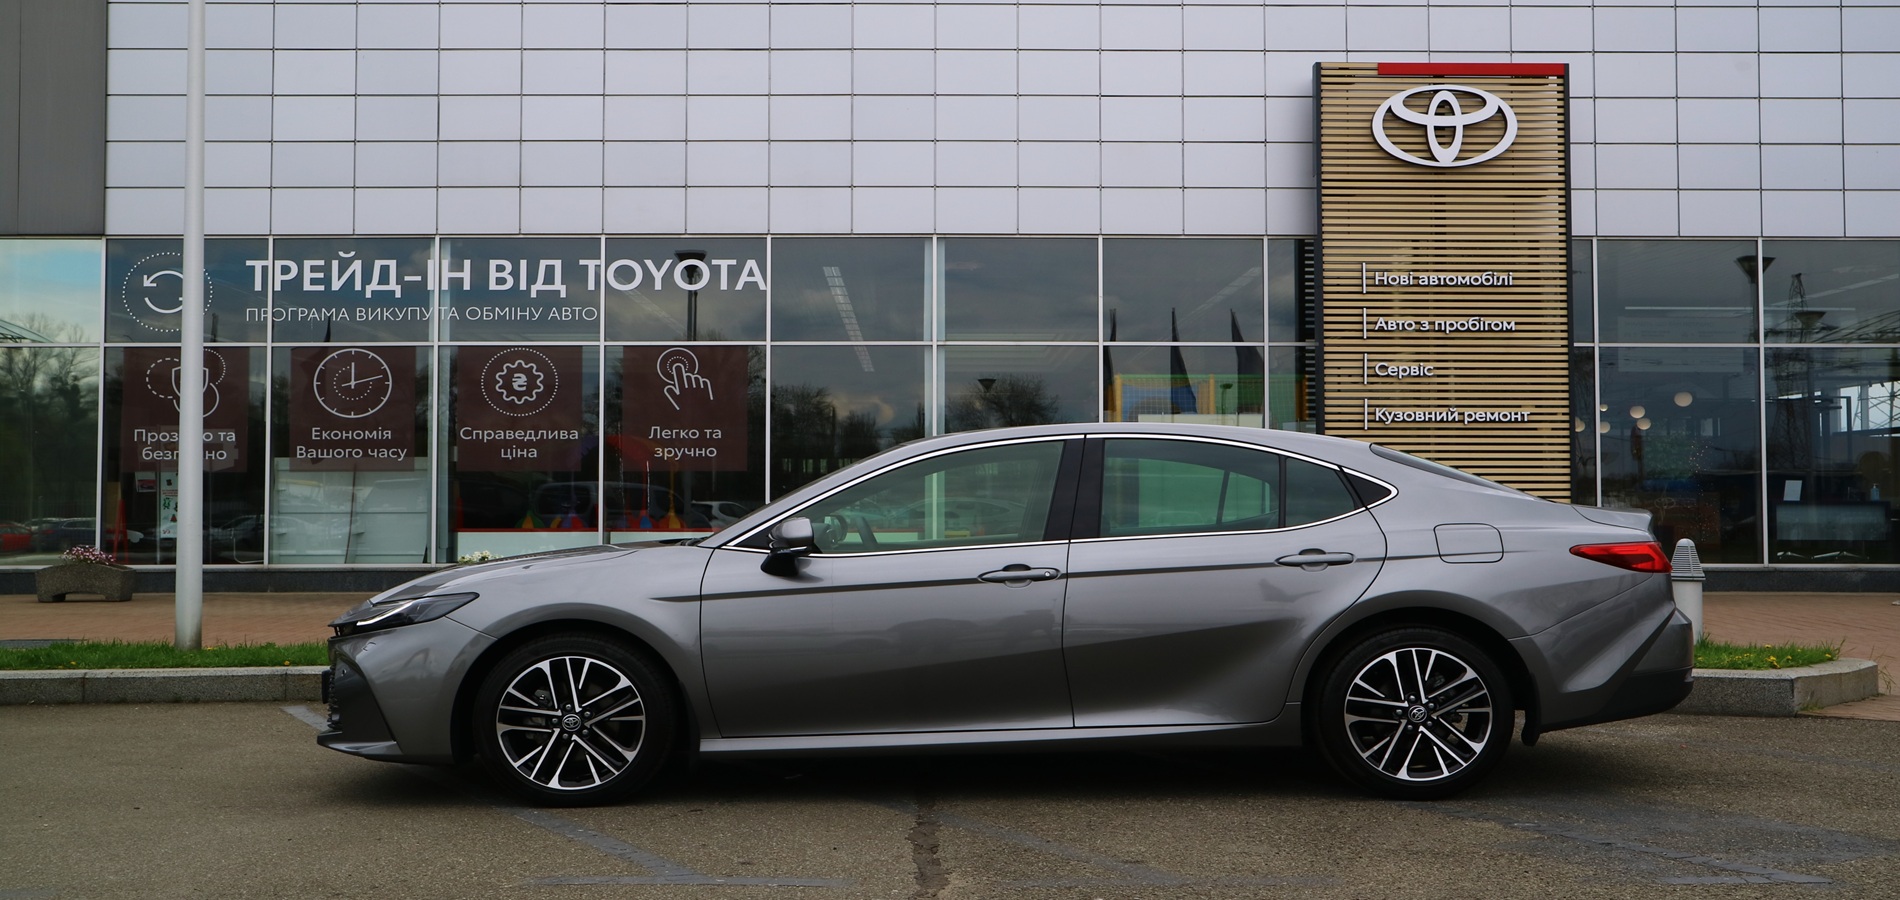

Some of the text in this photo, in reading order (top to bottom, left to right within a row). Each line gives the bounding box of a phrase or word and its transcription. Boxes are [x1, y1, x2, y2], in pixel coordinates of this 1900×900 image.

[246, 251, 767, 298] ТРЕЙД-ІН ВІД TOYOTA
[1374, 271, 1513, 286] Нові автомобілі
[246, 307, 598, 322] ПРОГРАМА ВИКУПУ ТА ОБМІНУ АВТО
[1374, 317, 1516, 334] Авто з пробігом
[1374, 362, 1434, 380] Сервіс
[1374, 407, 1530, 425] Кузовний ремонт
[133, 429, 236, 445] Прозо та
[311, 426, 392, 440] Економія
[459, 427, 579, 443] Справедлива
[648, 427, 722, 439] Легко та
[296, 446, 407, 461] Вашого часу
[501, 445, 538, 461] ціна
[654, 446, 718, 461] зручно
